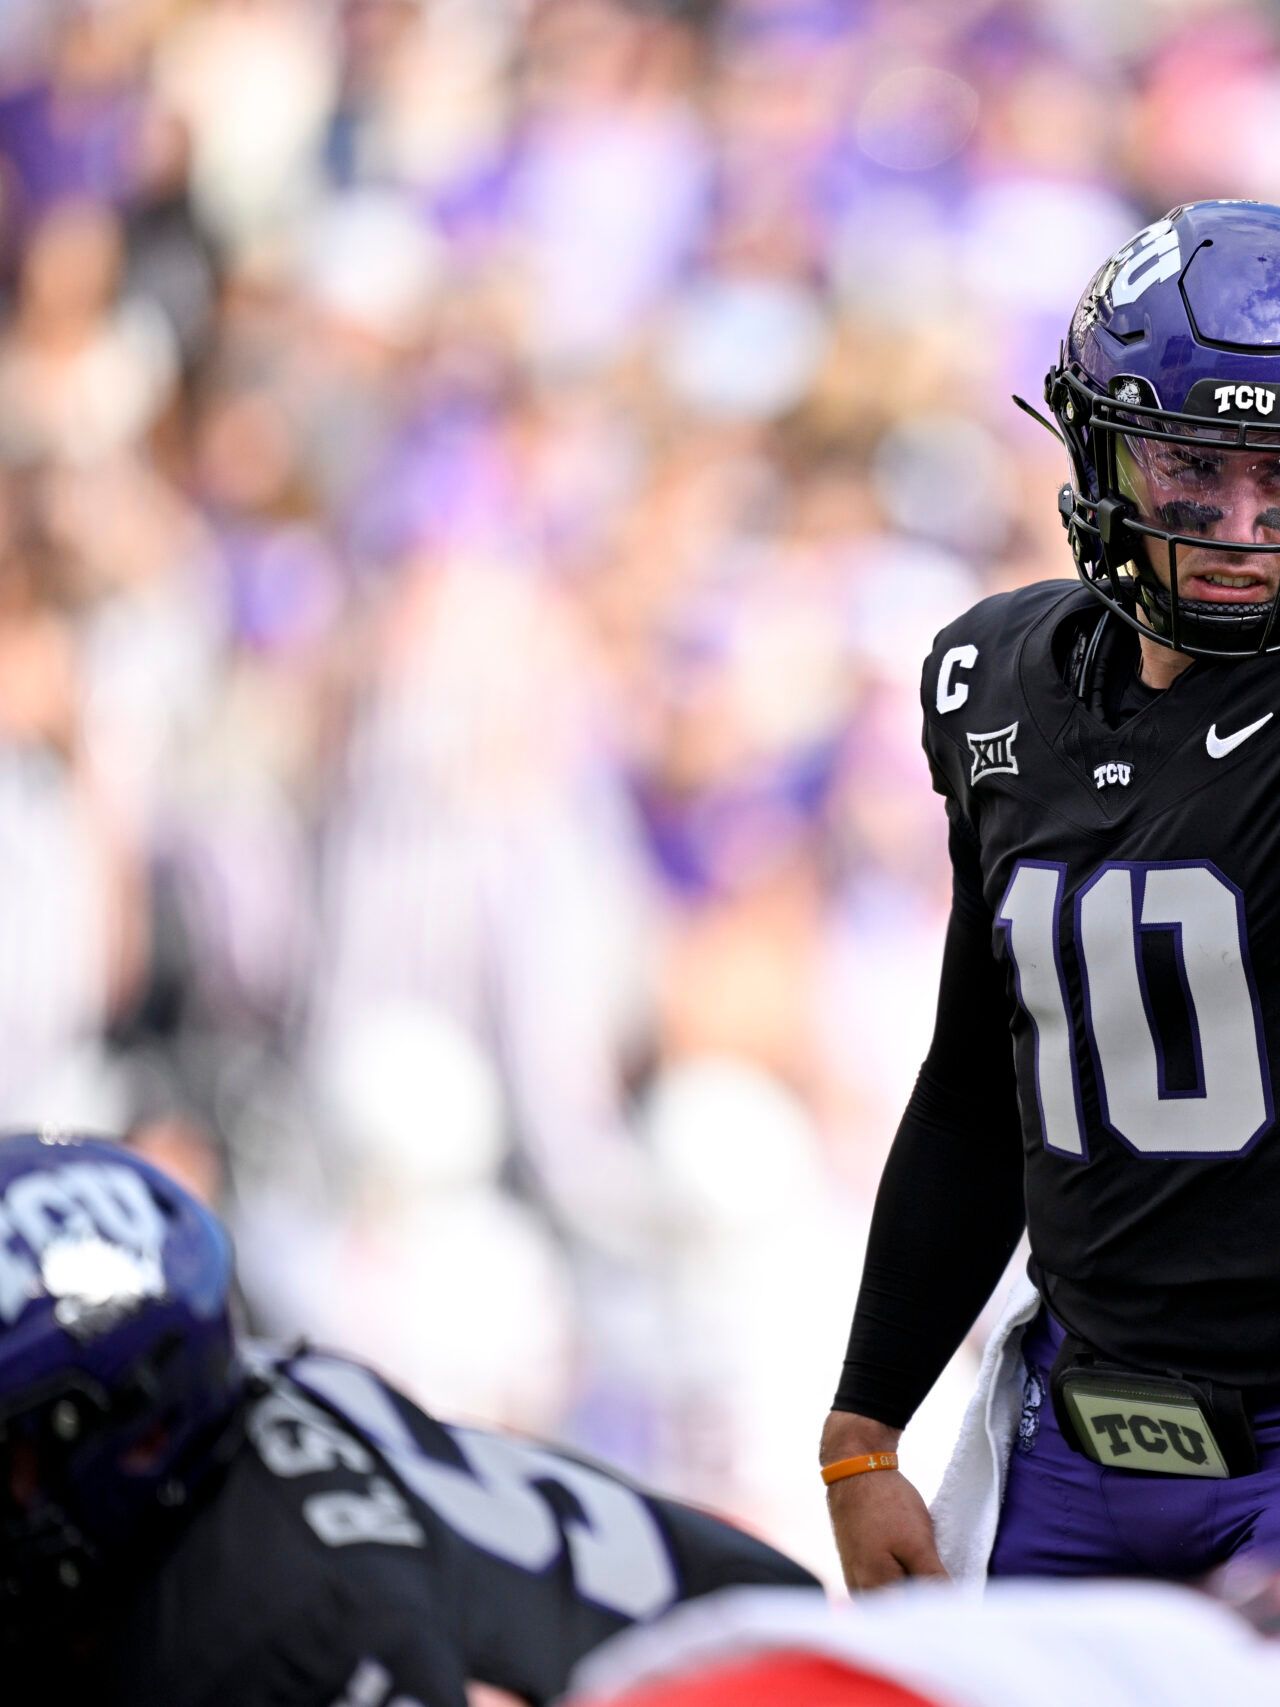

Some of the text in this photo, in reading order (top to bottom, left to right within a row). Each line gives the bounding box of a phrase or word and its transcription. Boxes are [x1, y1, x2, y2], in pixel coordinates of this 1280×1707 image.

[1214, 385, 1276, 415] TCU
[936, 644, 979, 714] C
[968, 732, 1017, 777] XII
[1093, 762, 1132, 789] TCU
[995, 858, 1276, 1162] 10
[1090, 1413, 1208, 1465] TCU
